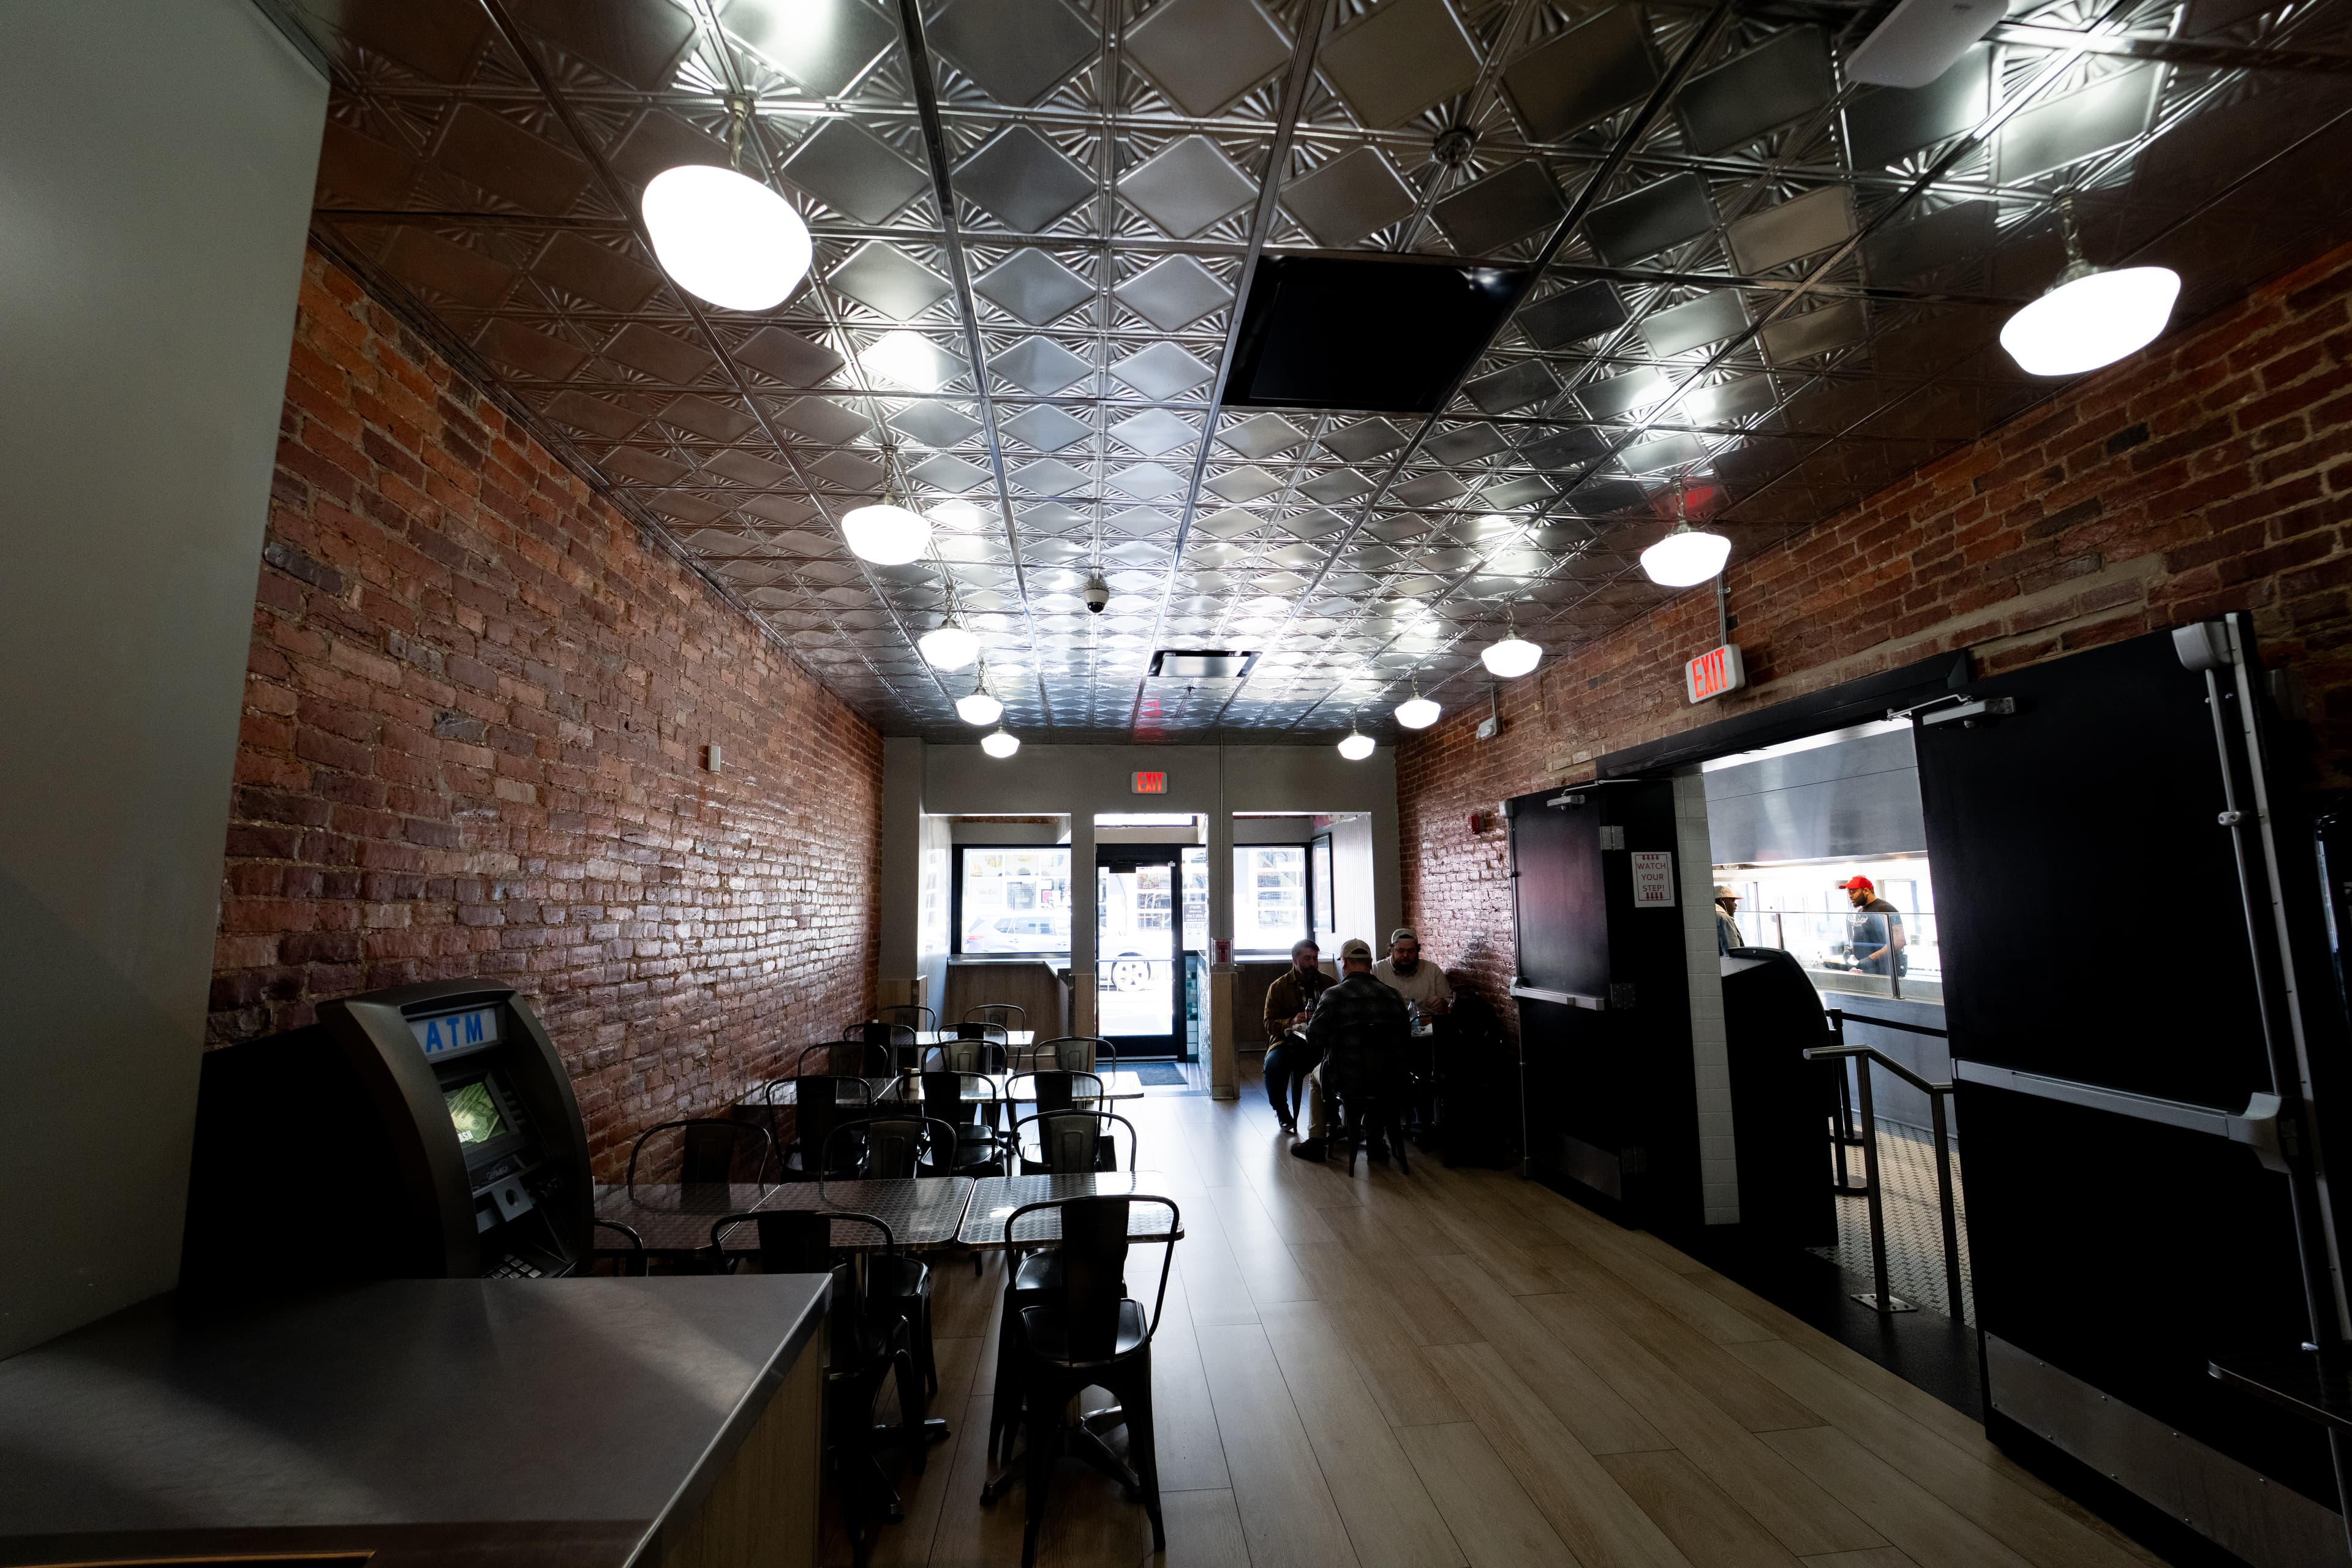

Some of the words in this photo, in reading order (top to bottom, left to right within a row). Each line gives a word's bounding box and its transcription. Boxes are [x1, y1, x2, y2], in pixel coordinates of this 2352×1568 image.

[1692, 648, 1727, 698] EXIT
[1137, 772, 1164, 793] EXIT
[426, 1014, 483, 1052] ATM
